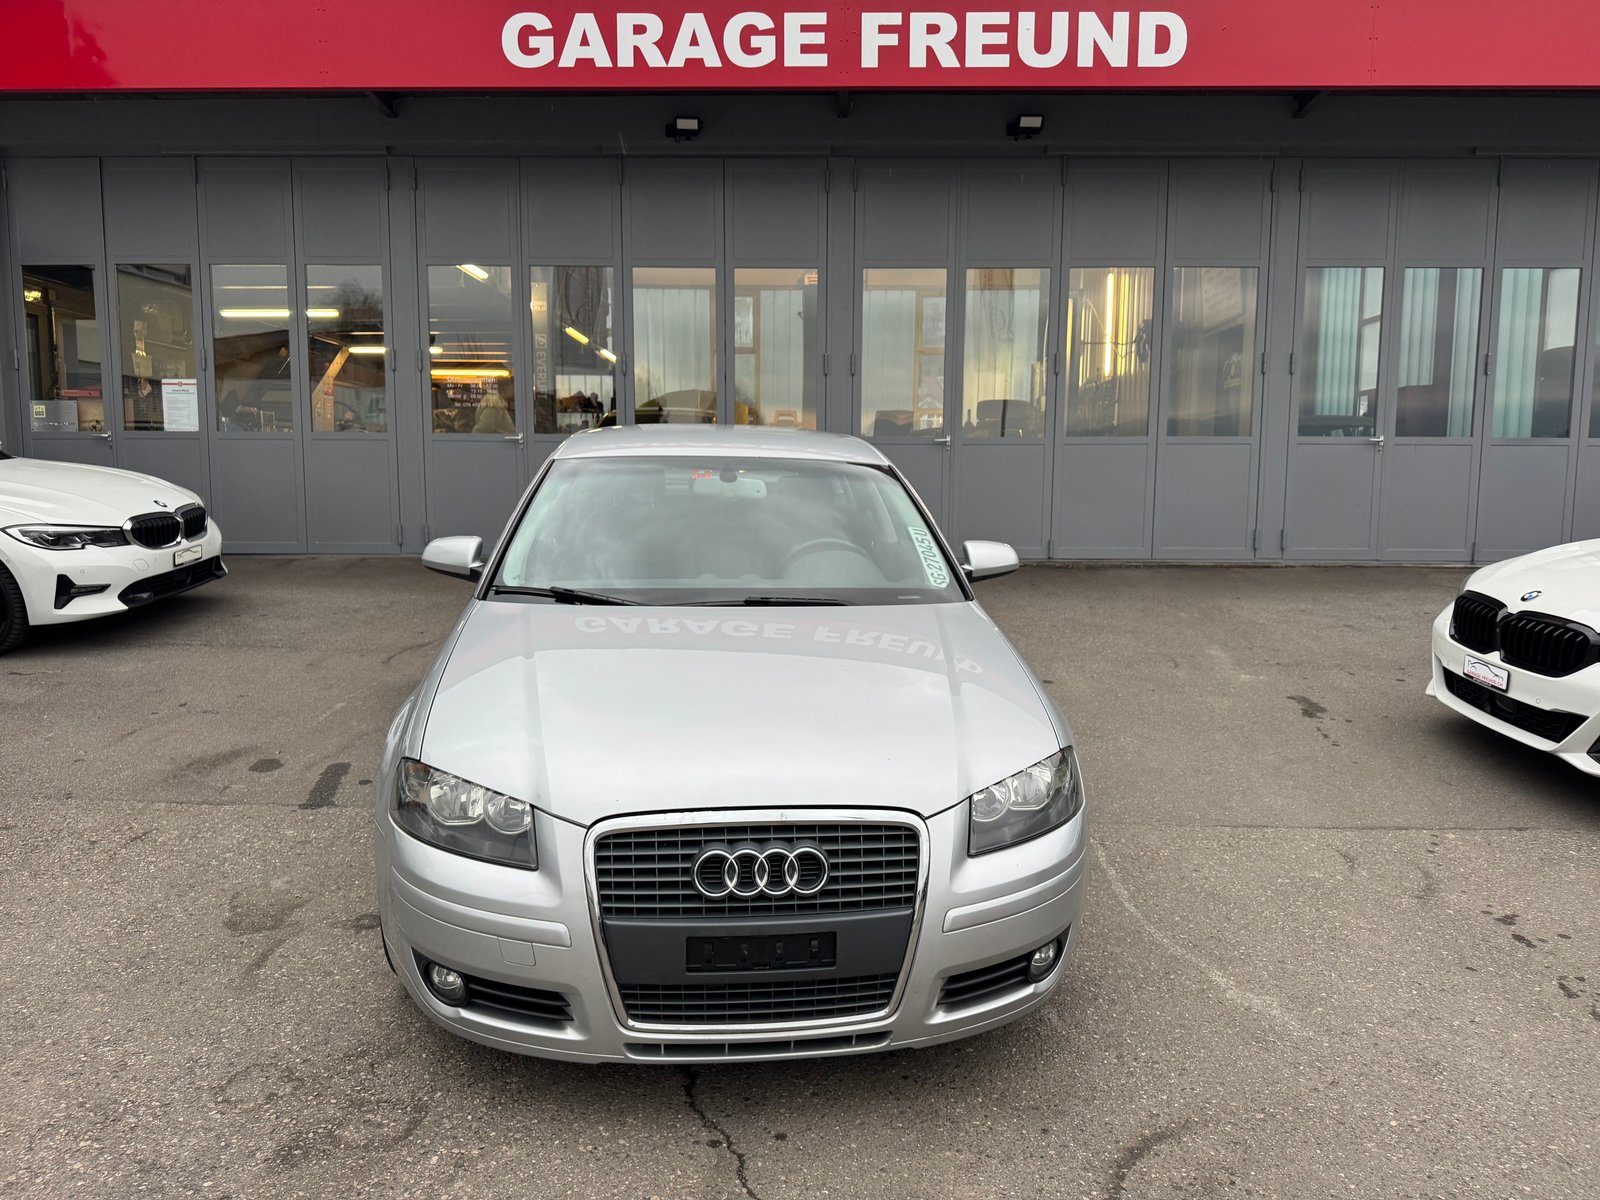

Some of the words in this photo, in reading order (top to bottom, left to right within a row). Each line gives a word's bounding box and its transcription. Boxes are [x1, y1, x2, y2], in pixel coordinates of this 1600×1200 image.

[501, 12, 828, 69] GARAGE
[861, 11, 1188, 69] FREUND
[536, 351, 548, 400] EVERLIFT
